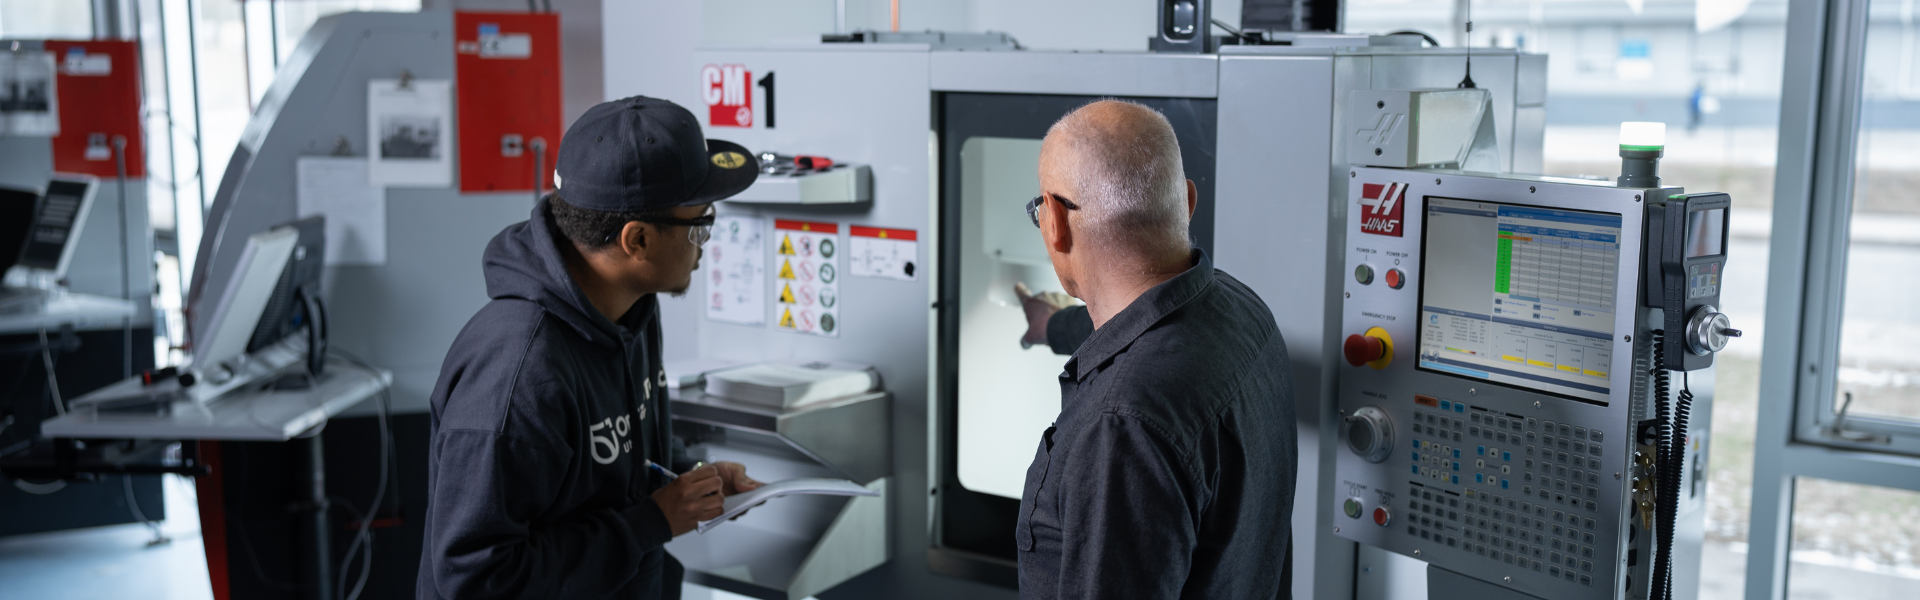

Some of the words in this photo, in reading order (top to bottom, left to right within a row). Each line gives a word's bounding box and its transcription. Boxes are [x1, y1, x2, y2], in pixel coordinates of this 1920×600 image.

[702, 65, 745, 106] CM
[758, 71, 775, 128] 1
[1361, 217, 1399, 233] HAAS
[1362, 311, 1385, 320] EMERGENCY
